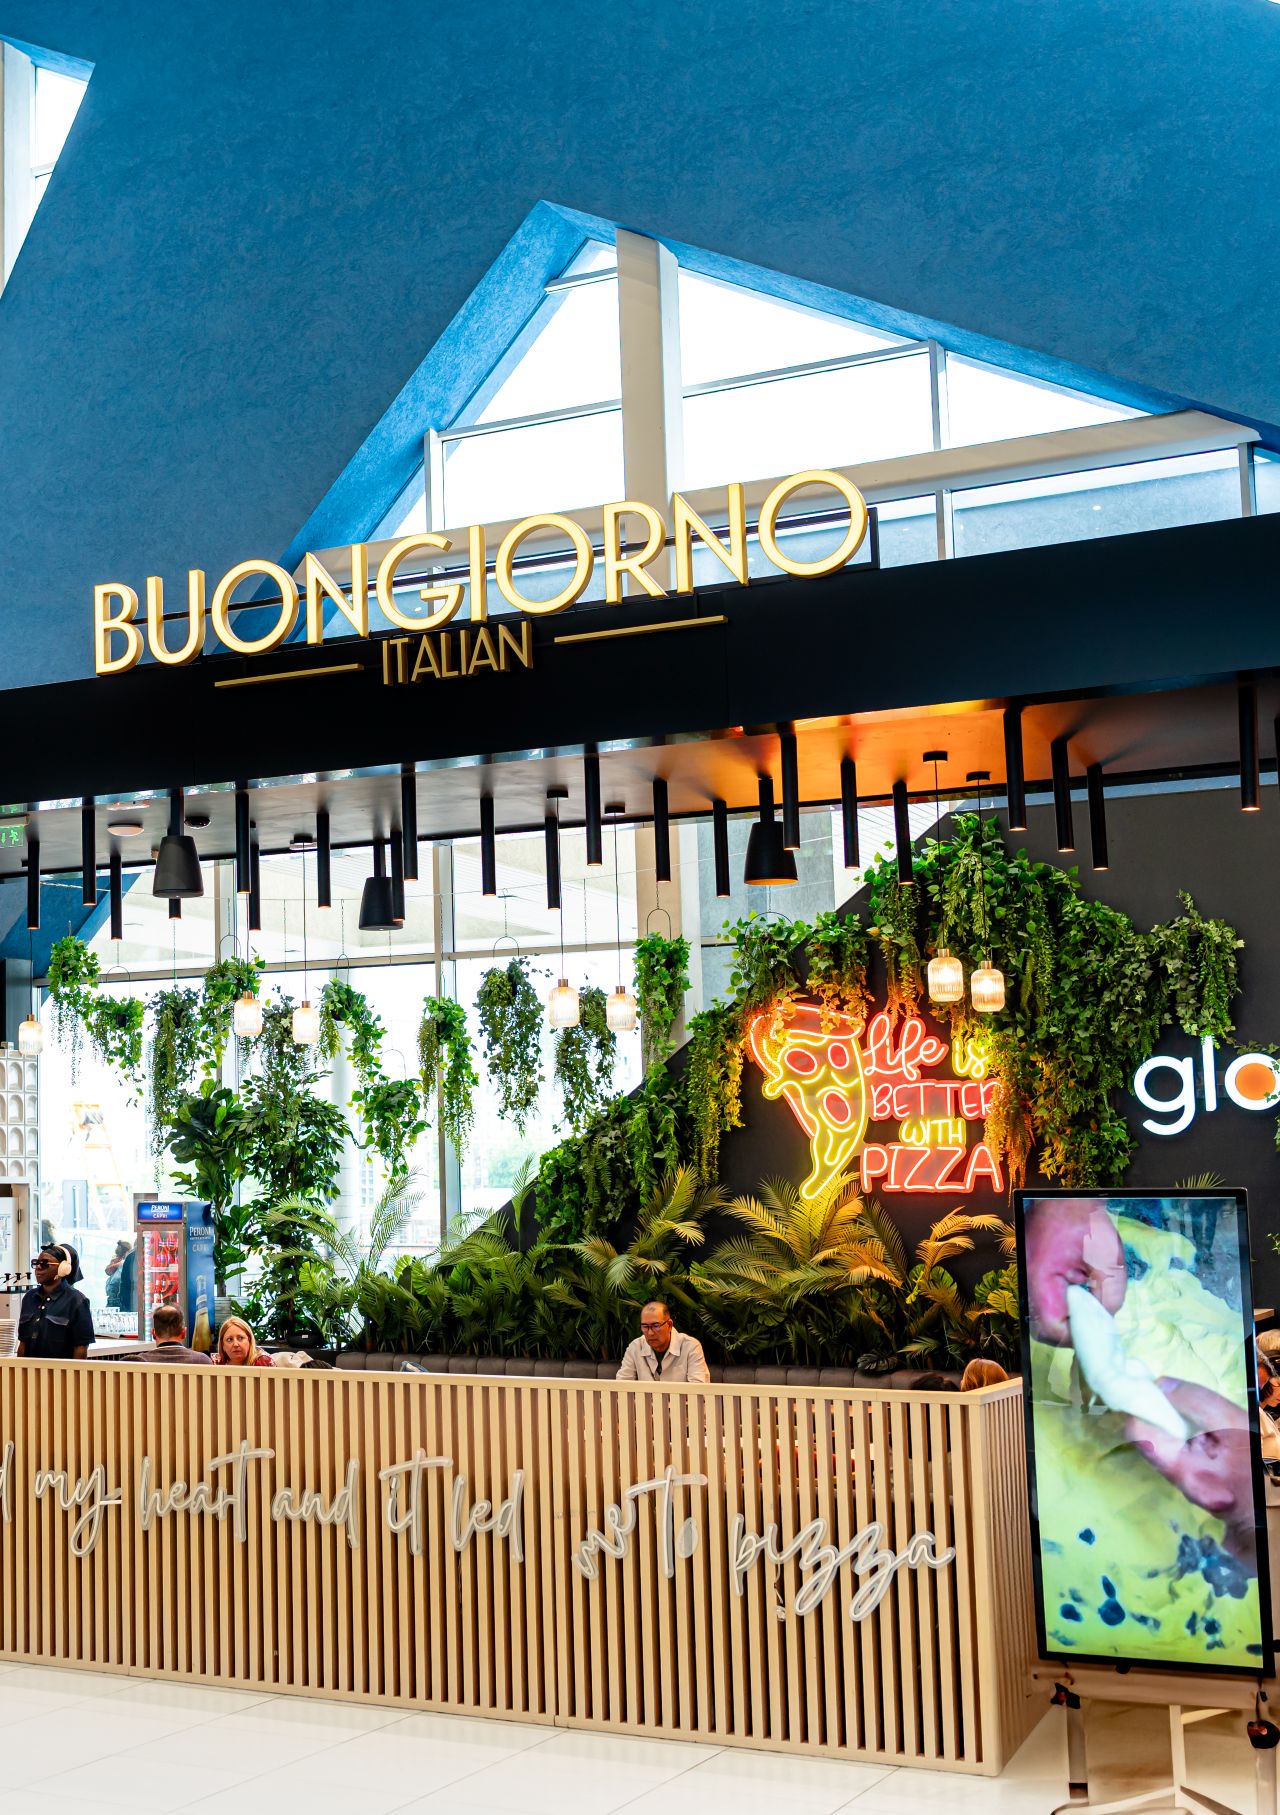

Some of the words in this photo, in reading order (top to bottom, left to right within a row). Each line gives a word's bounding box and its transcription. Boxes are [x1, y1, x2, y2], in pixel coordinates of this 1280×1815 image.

[94, 469, 868, 675] BUONGIORNO
[381, 620, 533, 687] ITALIAN
[870, 1081, 1005, 1119] BETTER
[1133, 1033, 1280, 1136] glo
[900, 1119, 966, 1146] WITH
[860, 1143, 1005, 1193] PIZZA
[189, 1226, 211, 1236] PERONI
[34, 1464, 123, 1558] my
[140, 1439, 276, 1543] heart
[272, 1458, 360, 1548] and
[451, 1468, 526, 1563] led
[731, 1512, 957, 1622] pizza
